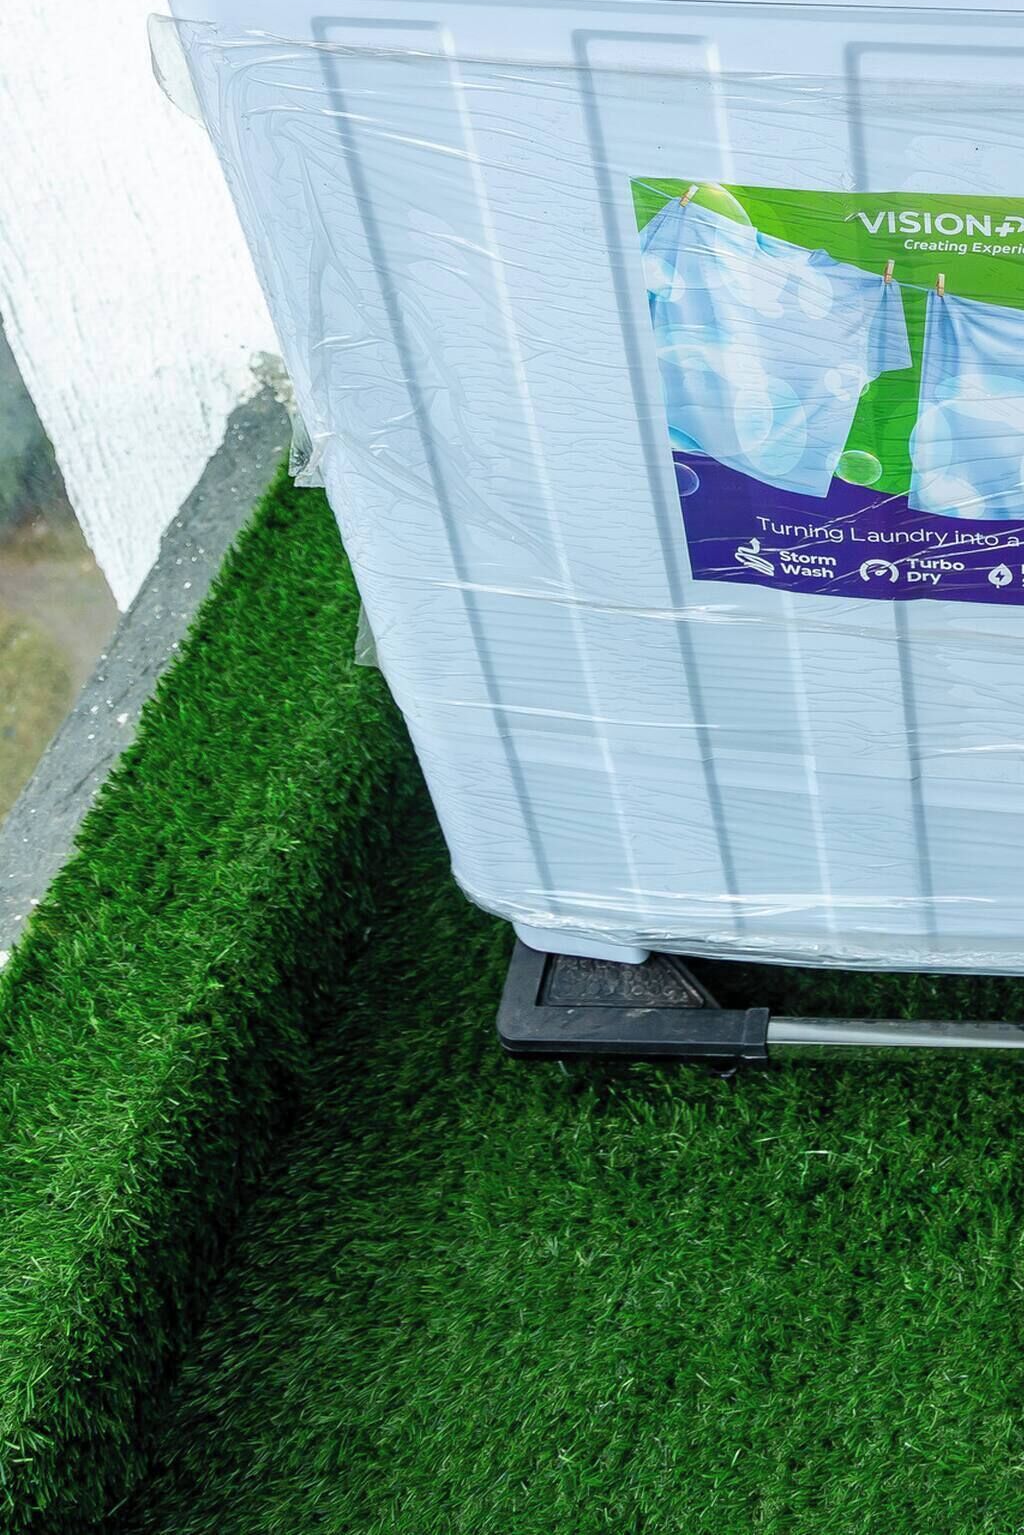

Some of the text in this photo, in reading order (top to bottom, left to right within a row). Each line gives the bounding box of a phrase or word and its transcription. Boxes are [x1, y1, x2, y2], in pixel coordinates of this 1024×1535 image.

[904, 238, 967, 255] Creating
[757, 516, 844, 542] Turning
[851, 528, 948, 546] Laundry
[954, 530, 999, 546] into
[1007, 535, 1020, 547] a
[779, 550, 837, 566] Storm
[907, 558, 965, 571] Turbo
[781, 563, 835, 578] Wash
[907, 571, 941, 585] Dry
